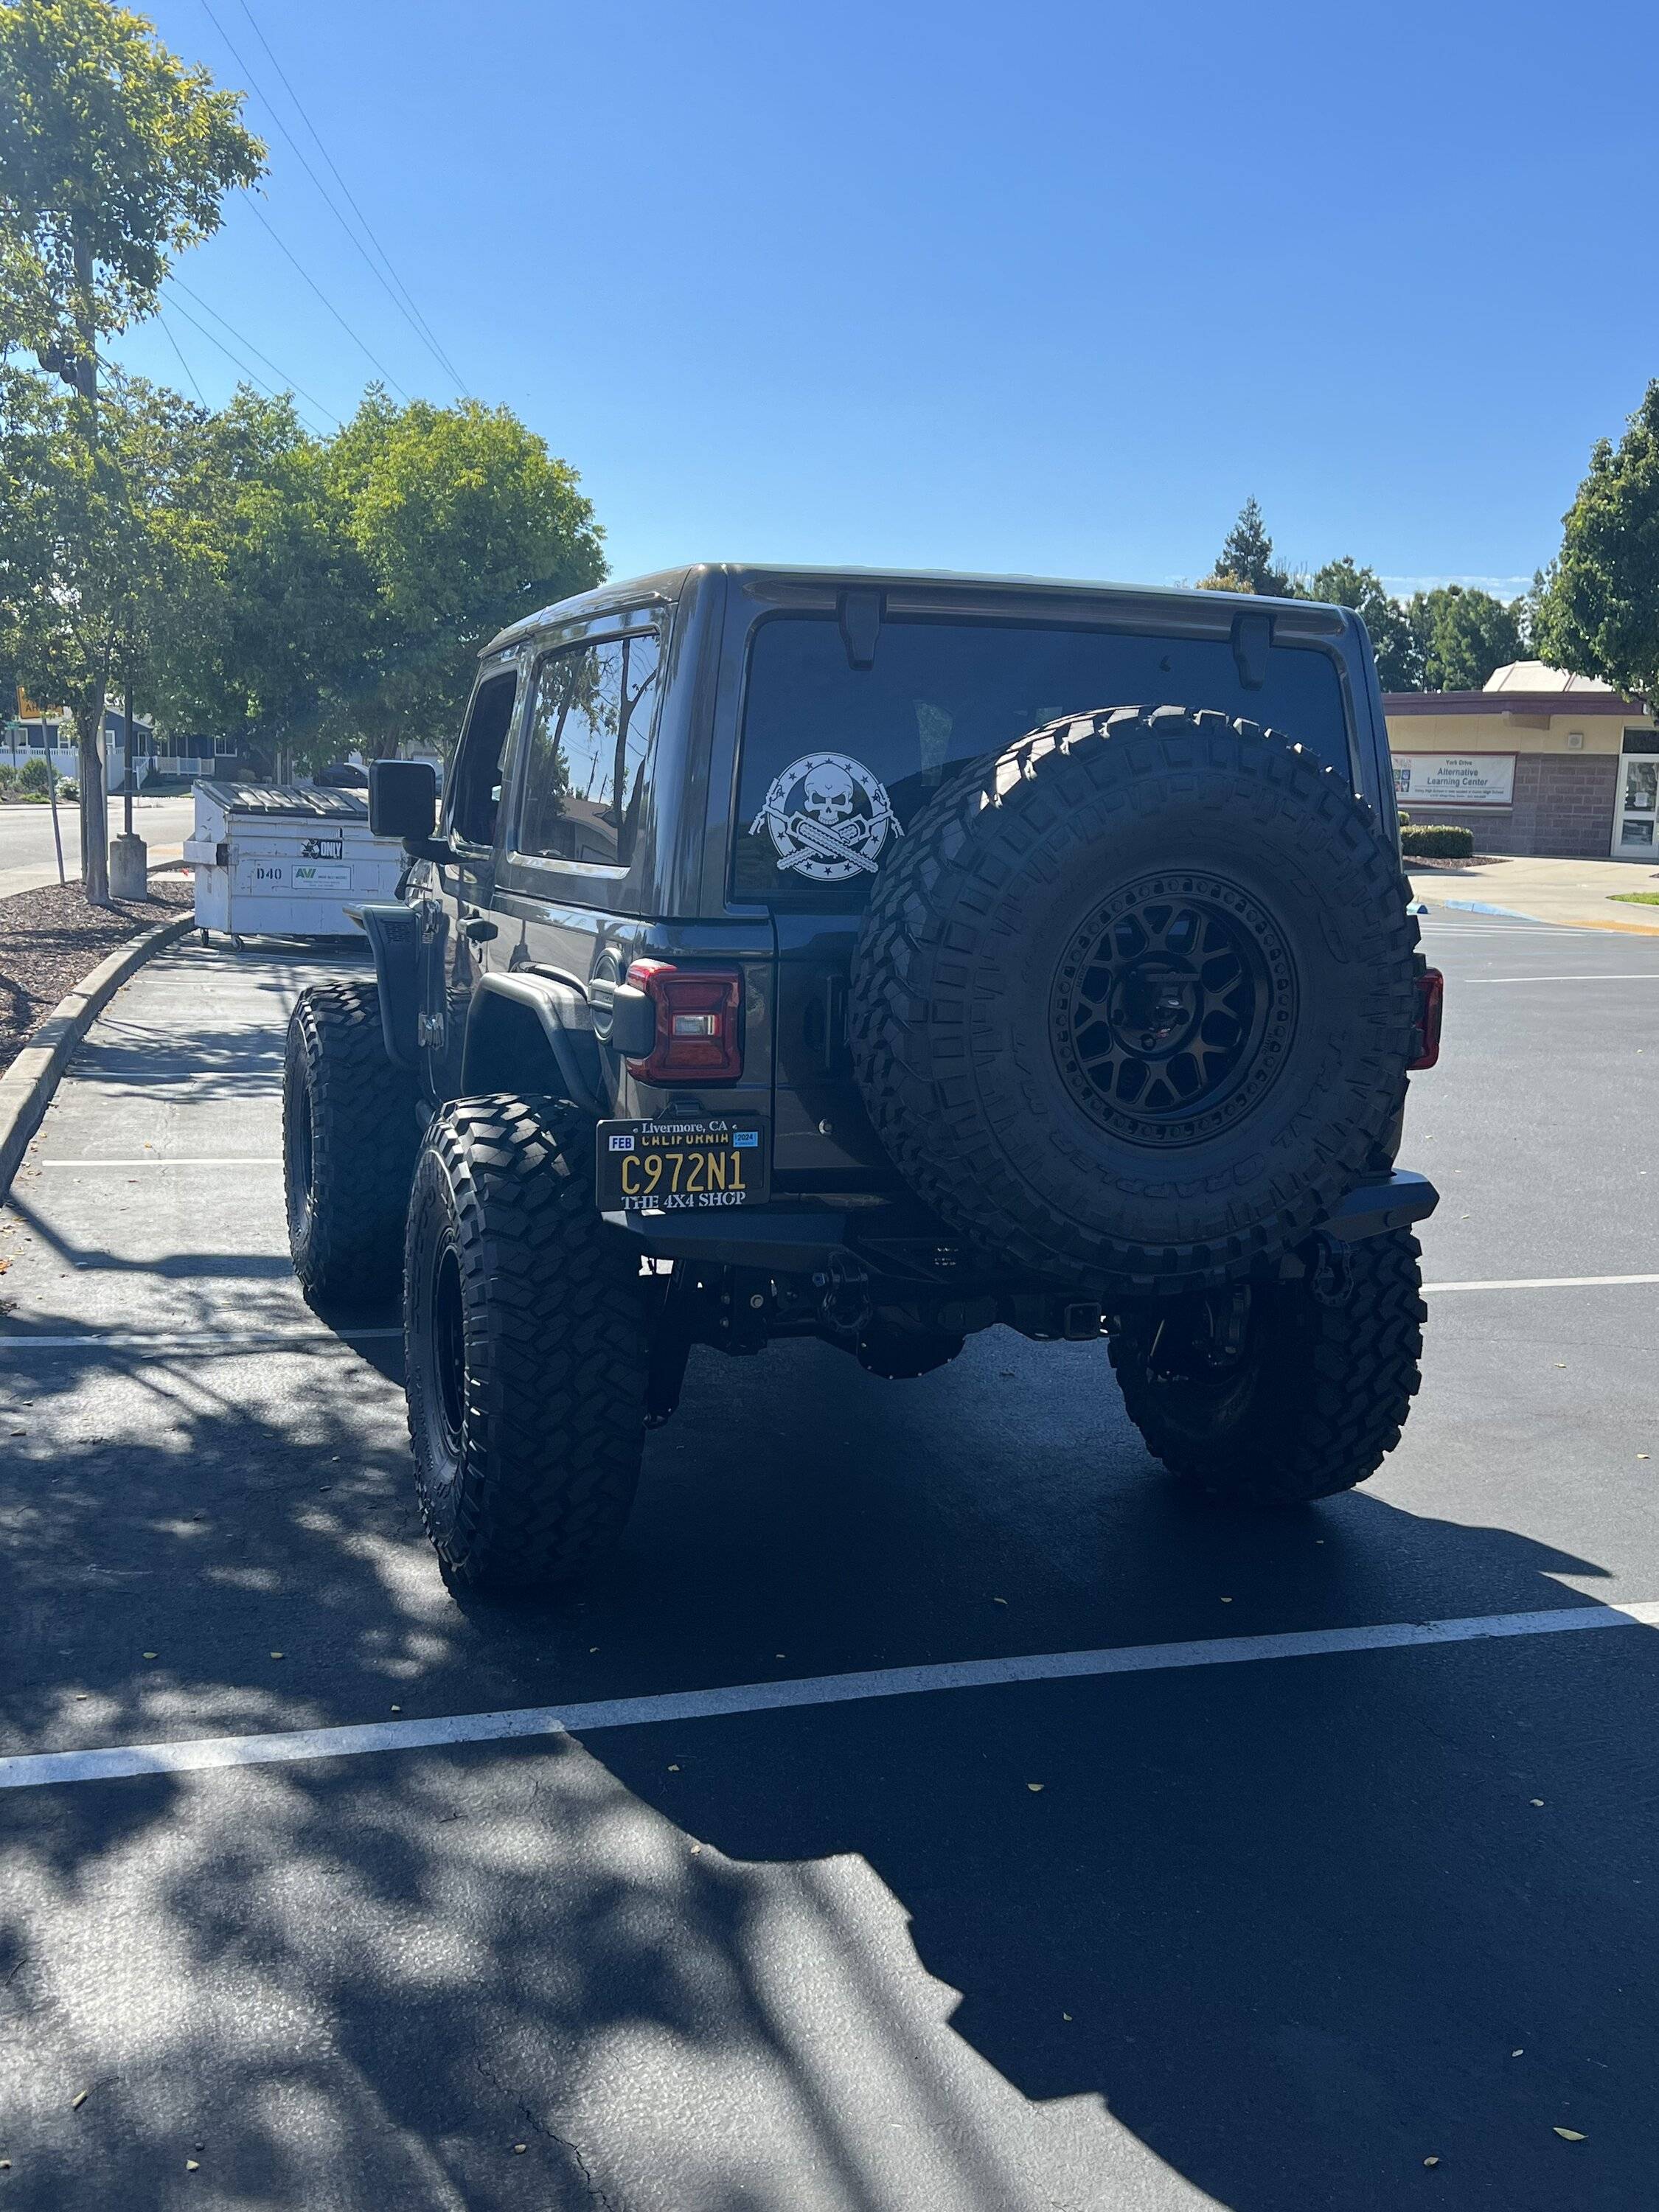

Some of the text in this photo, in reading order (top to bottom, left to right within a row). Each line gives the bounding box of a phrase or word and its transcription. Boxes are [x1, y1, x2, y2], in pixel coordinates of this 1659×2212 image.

[1437, 768, 1478, 776] Alternative
[1427, 777, 1488, 787] Learning Center
[320, 841, 341, 858] ONLY
[296, 868, 317, 879] AVI
[641, 1120, 728, 1133] Livermore, CA
[612, 1137, 632, 1149] FEB
[737, 1133, 754, 1141] 2024
[622, 1151, 745, 1194] C972N1
[621, 1191, 746, 1210] THE 4X4 SHOP
